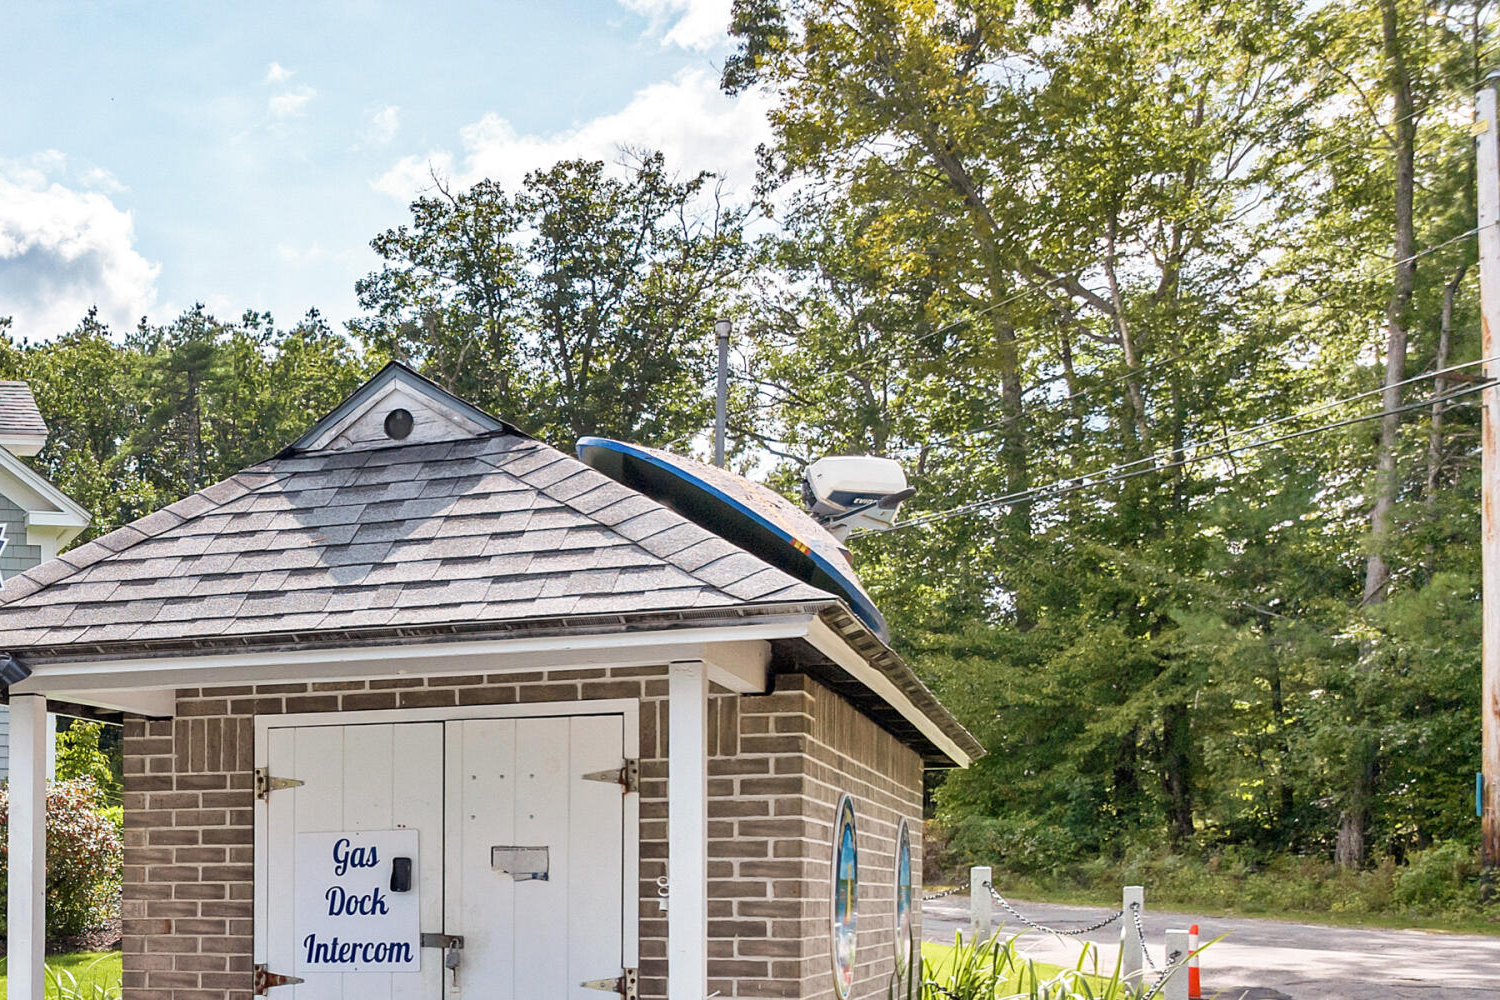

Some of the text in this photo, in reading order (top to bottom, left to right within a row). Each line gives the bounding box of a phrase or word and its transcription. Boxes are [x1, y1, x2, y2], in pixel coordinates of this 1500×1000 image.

[332, 838, 380, 876] Gas
[325, 886, 389, 916] Dock
[303, 933, 414, 963] Intercom
